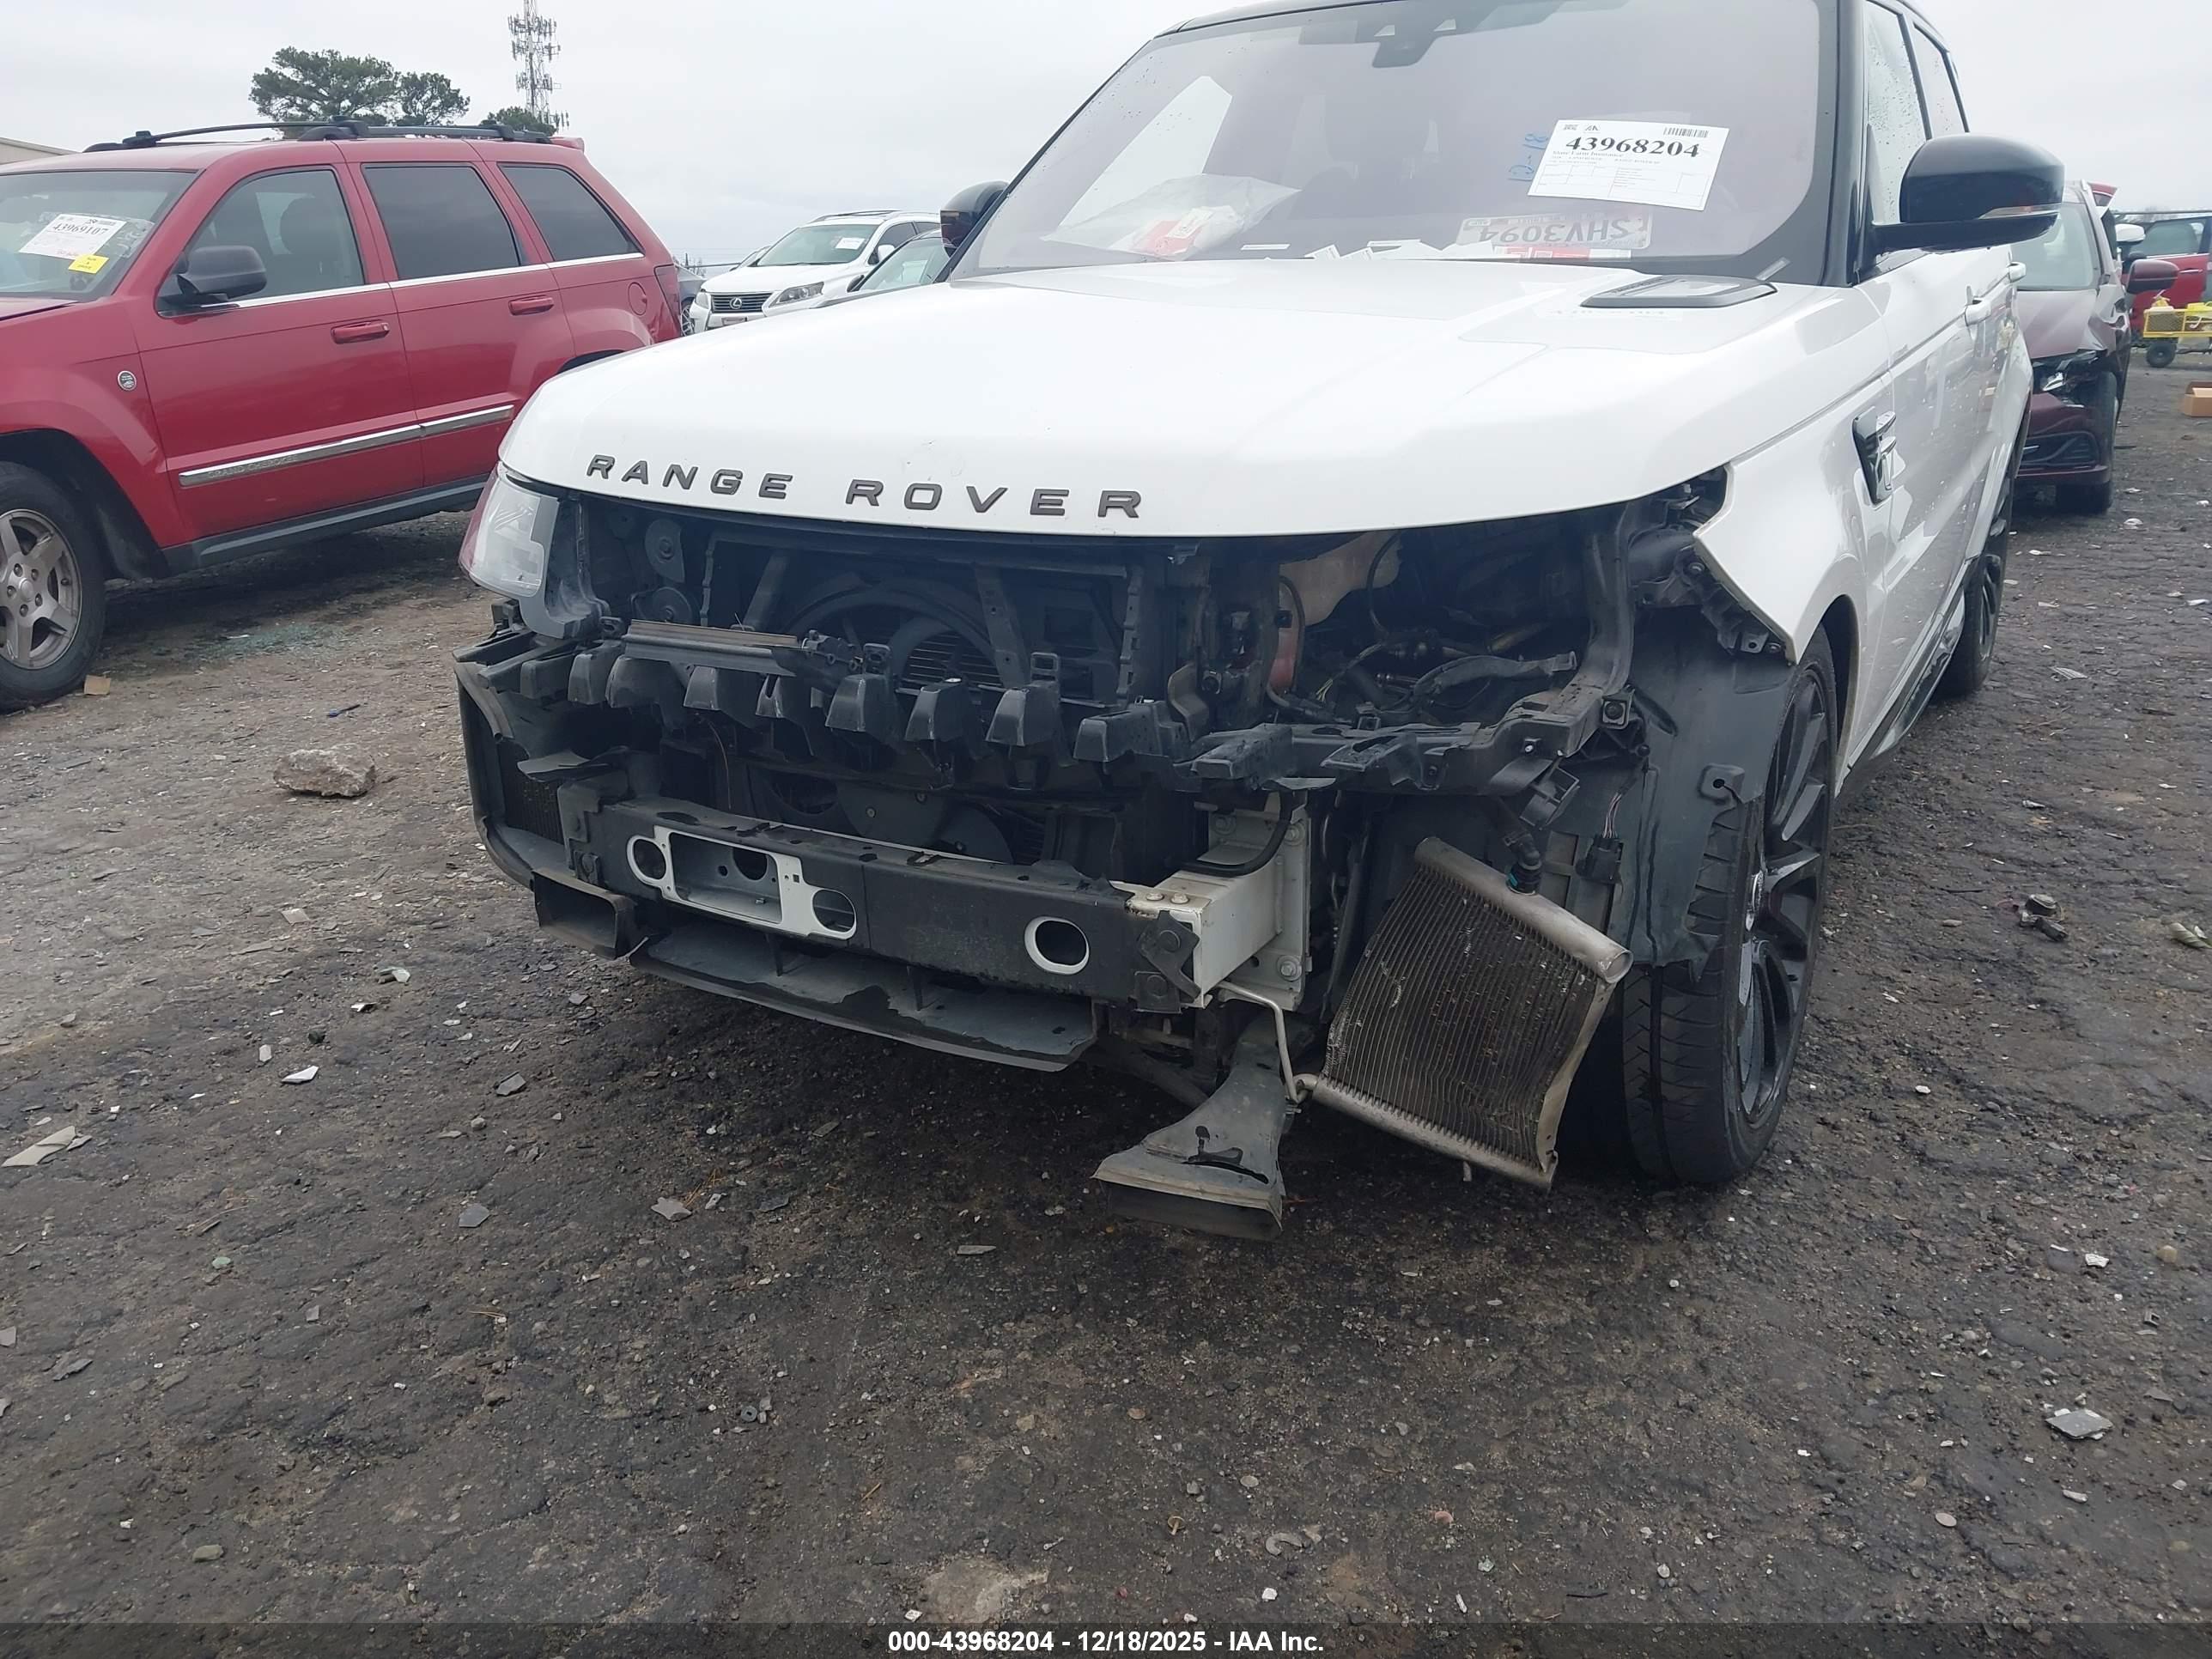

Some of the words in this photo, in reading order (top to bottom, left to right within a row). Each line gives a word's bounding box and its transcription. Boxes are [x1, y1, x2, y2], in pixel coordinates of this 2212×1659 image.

[1565, 136, 1700, 159] 43968204
[52, 222, 109, 235] 43969107
[1479, 219, 1631, 243] SHV3094
[586, 454, 793, 500] RANGE
[845, 478, 1142, 519] ROVER
